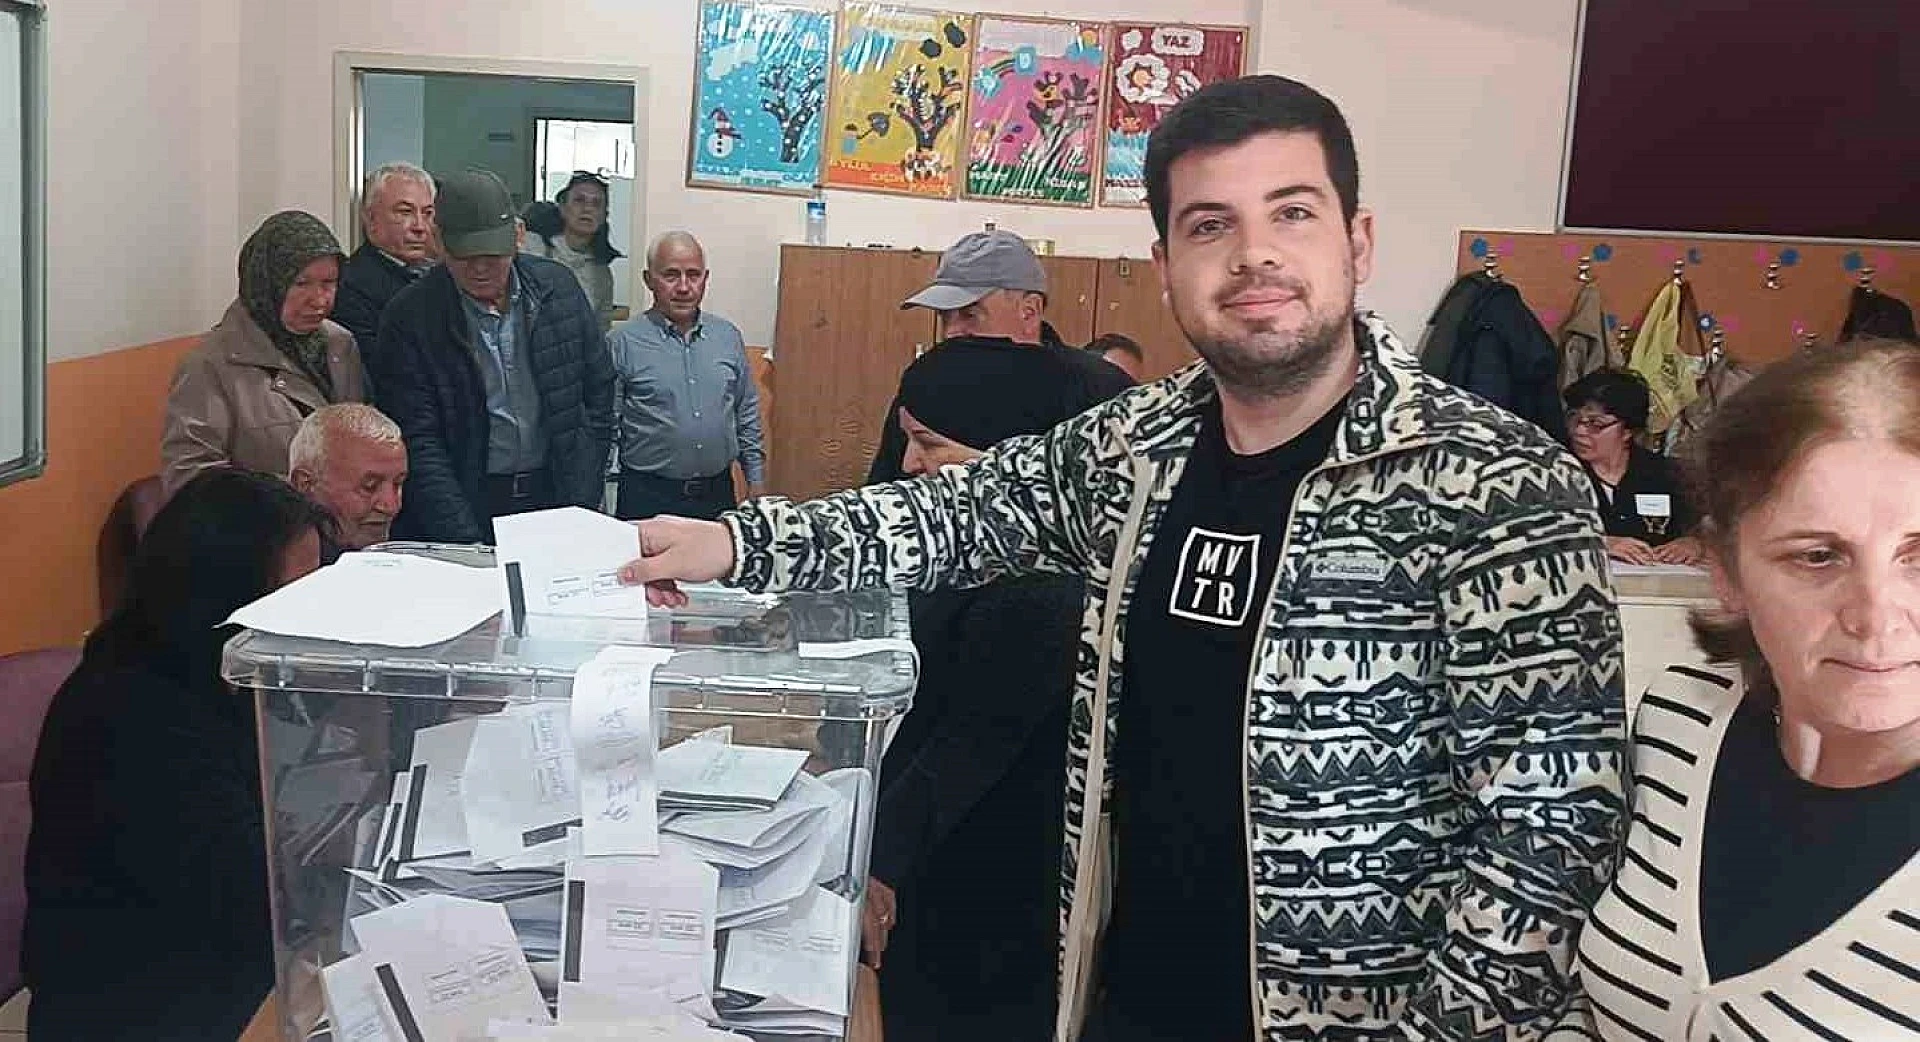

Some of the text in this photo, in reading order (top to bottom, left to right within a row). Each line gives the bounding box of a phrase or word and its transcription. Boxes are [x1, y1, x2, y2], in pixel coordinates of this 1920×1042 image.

[1162, 34, 1191, 49] YAZ
[1196, 541, 1244, 577] MV
[1328, 561, 1381, 574] Columbia
[1191, 576, 1235, 616] TR
